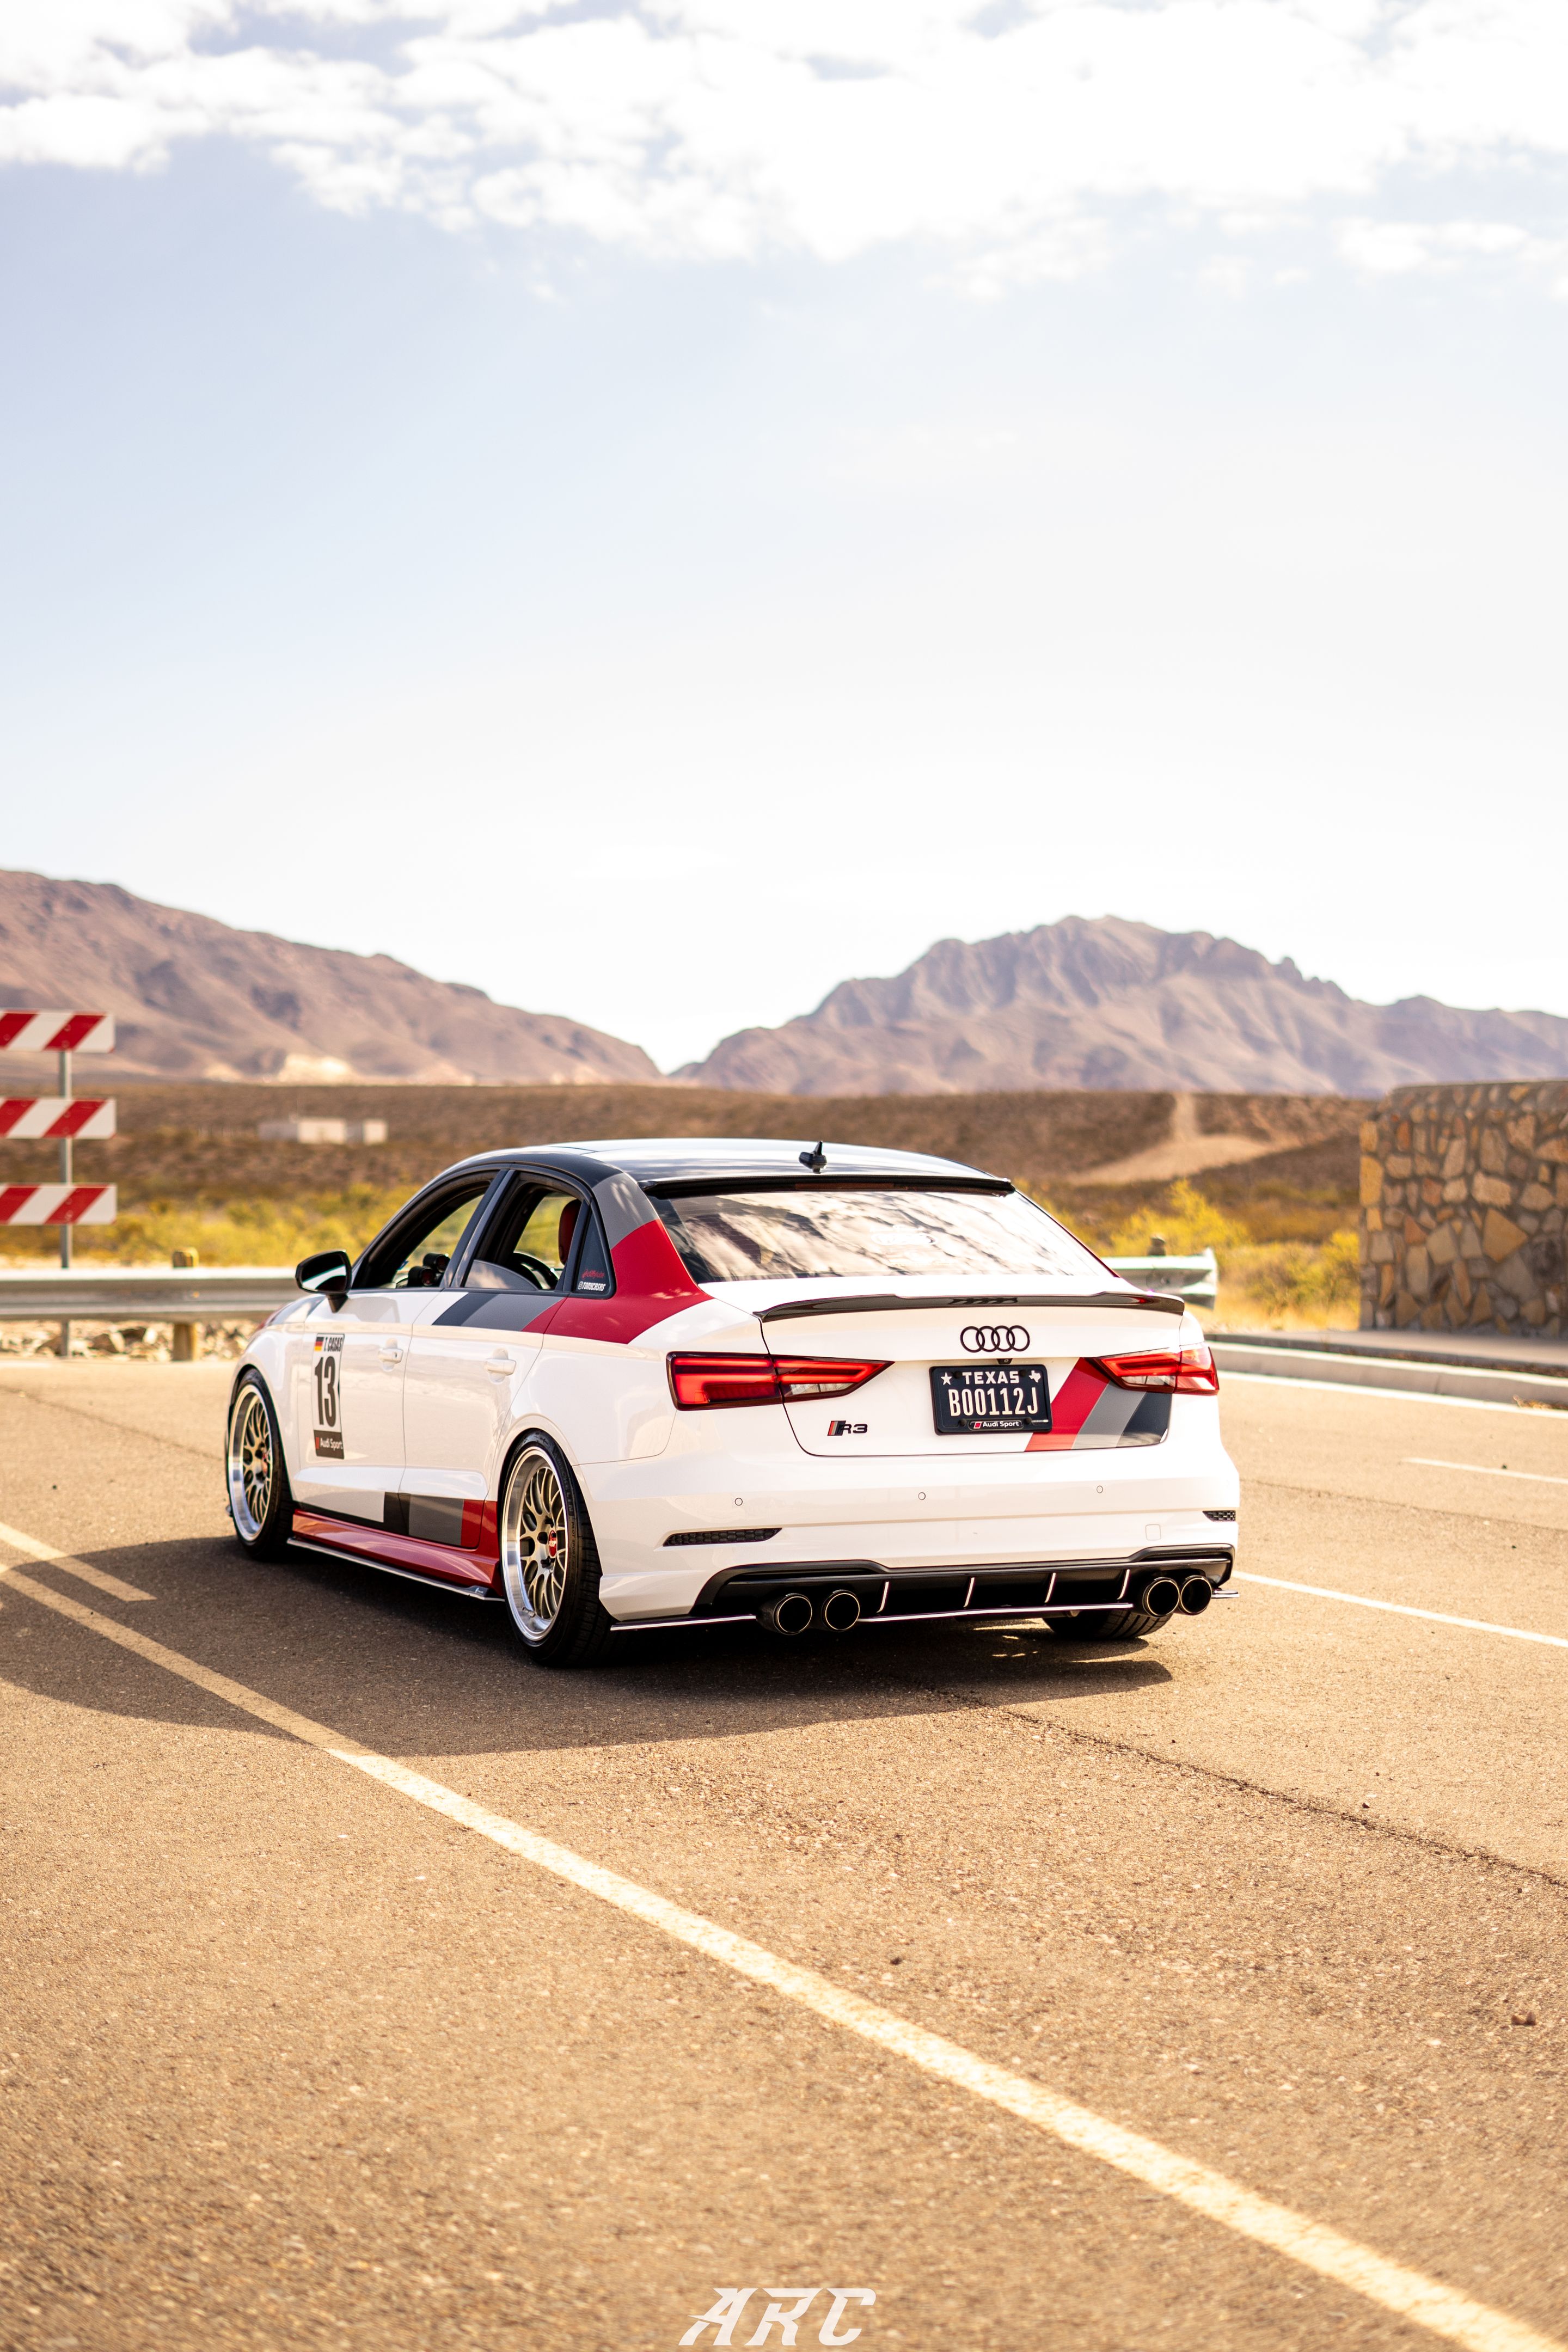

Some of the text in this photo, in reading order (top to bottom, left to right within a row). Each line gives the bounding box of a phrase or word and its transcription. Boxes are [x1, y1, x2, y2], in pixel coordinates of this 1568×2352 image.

[962, 1371, 1019, 1385] TEXAS
[315, 1356, 336, 1427] 13
[320, 1437, 343, 1451] Audi Sport
